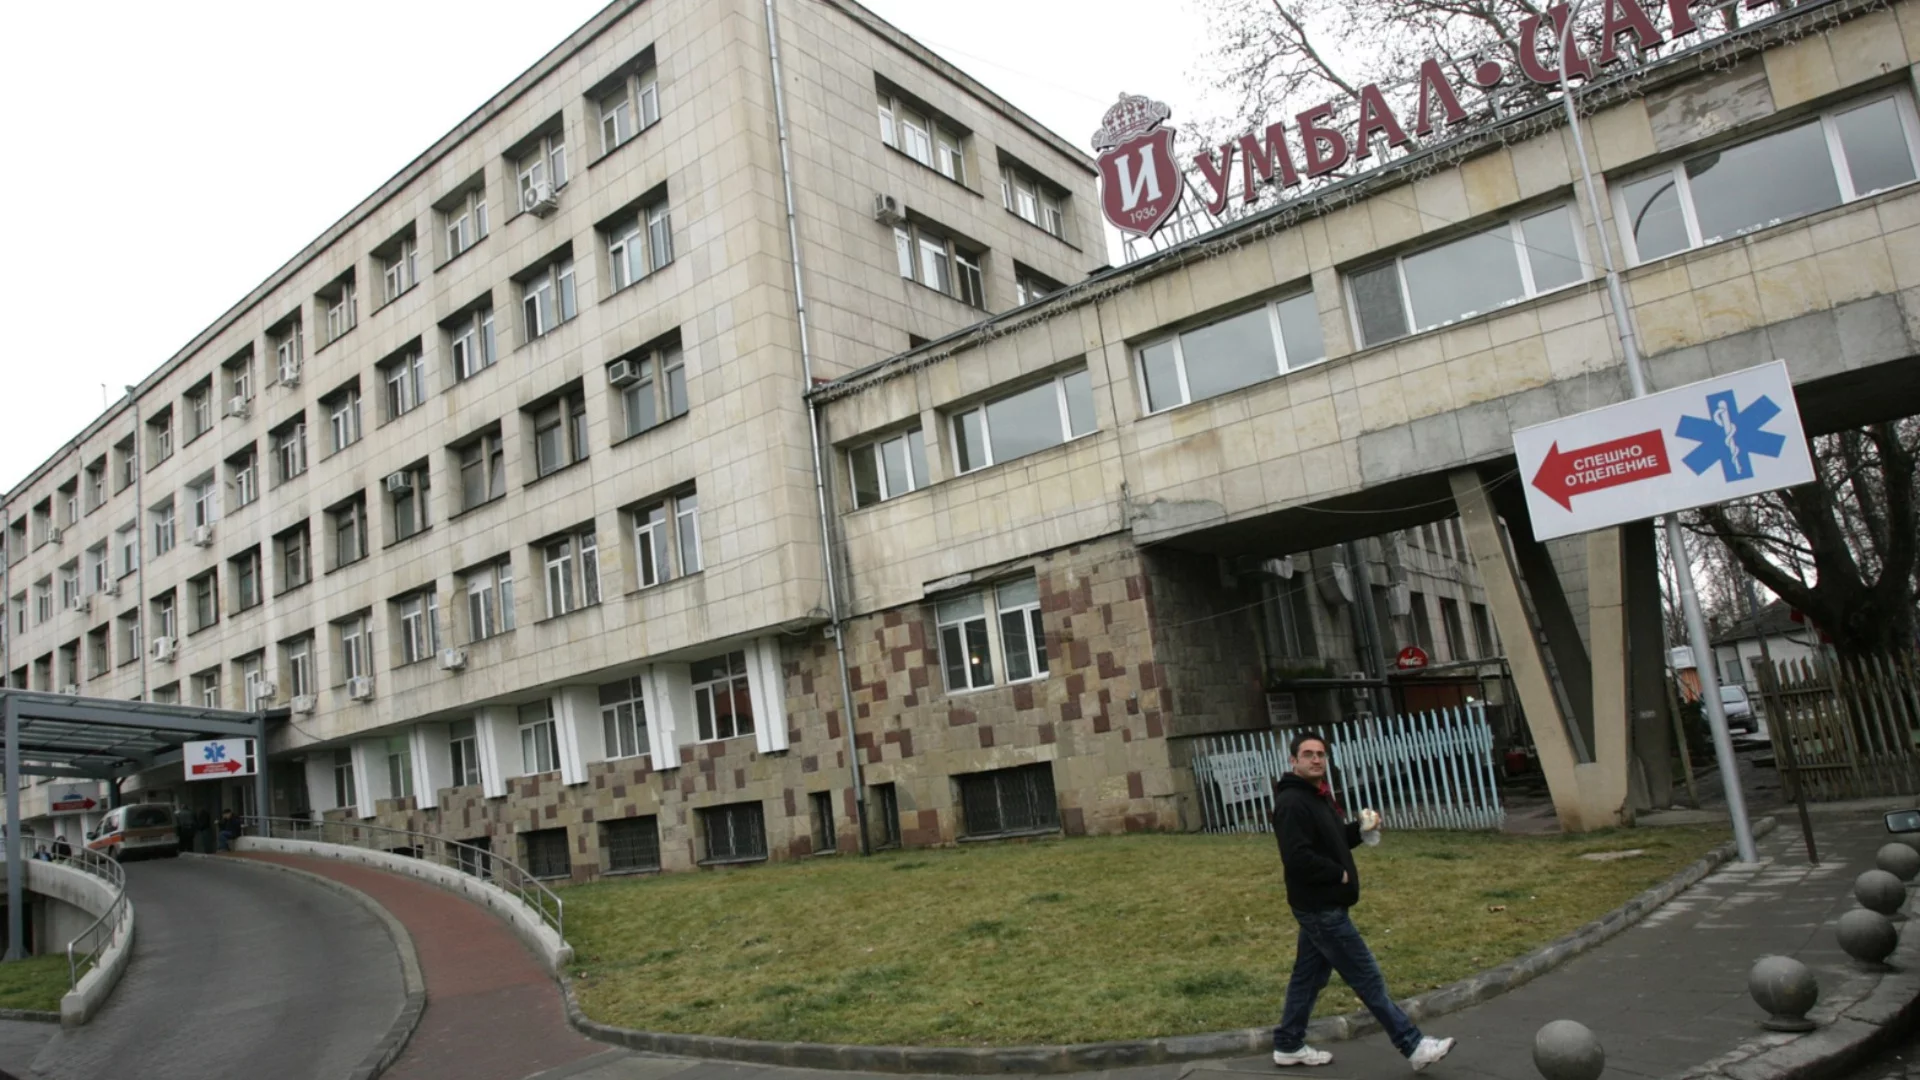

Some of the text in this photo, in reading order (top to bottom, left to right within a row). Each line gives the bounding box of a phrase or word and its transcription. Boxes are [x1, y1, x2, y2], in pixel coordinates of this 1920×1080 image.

[1193, 58, 1467, 216] УМБАЛ
[1114, 143, 1162, 212] И
[1130, 206, 1157, 223] 1936
[1565, 455, 1658, 486] ОТДЕЛЕНИЕ
[1574, 445, 1643, 471] СПЕШНО
